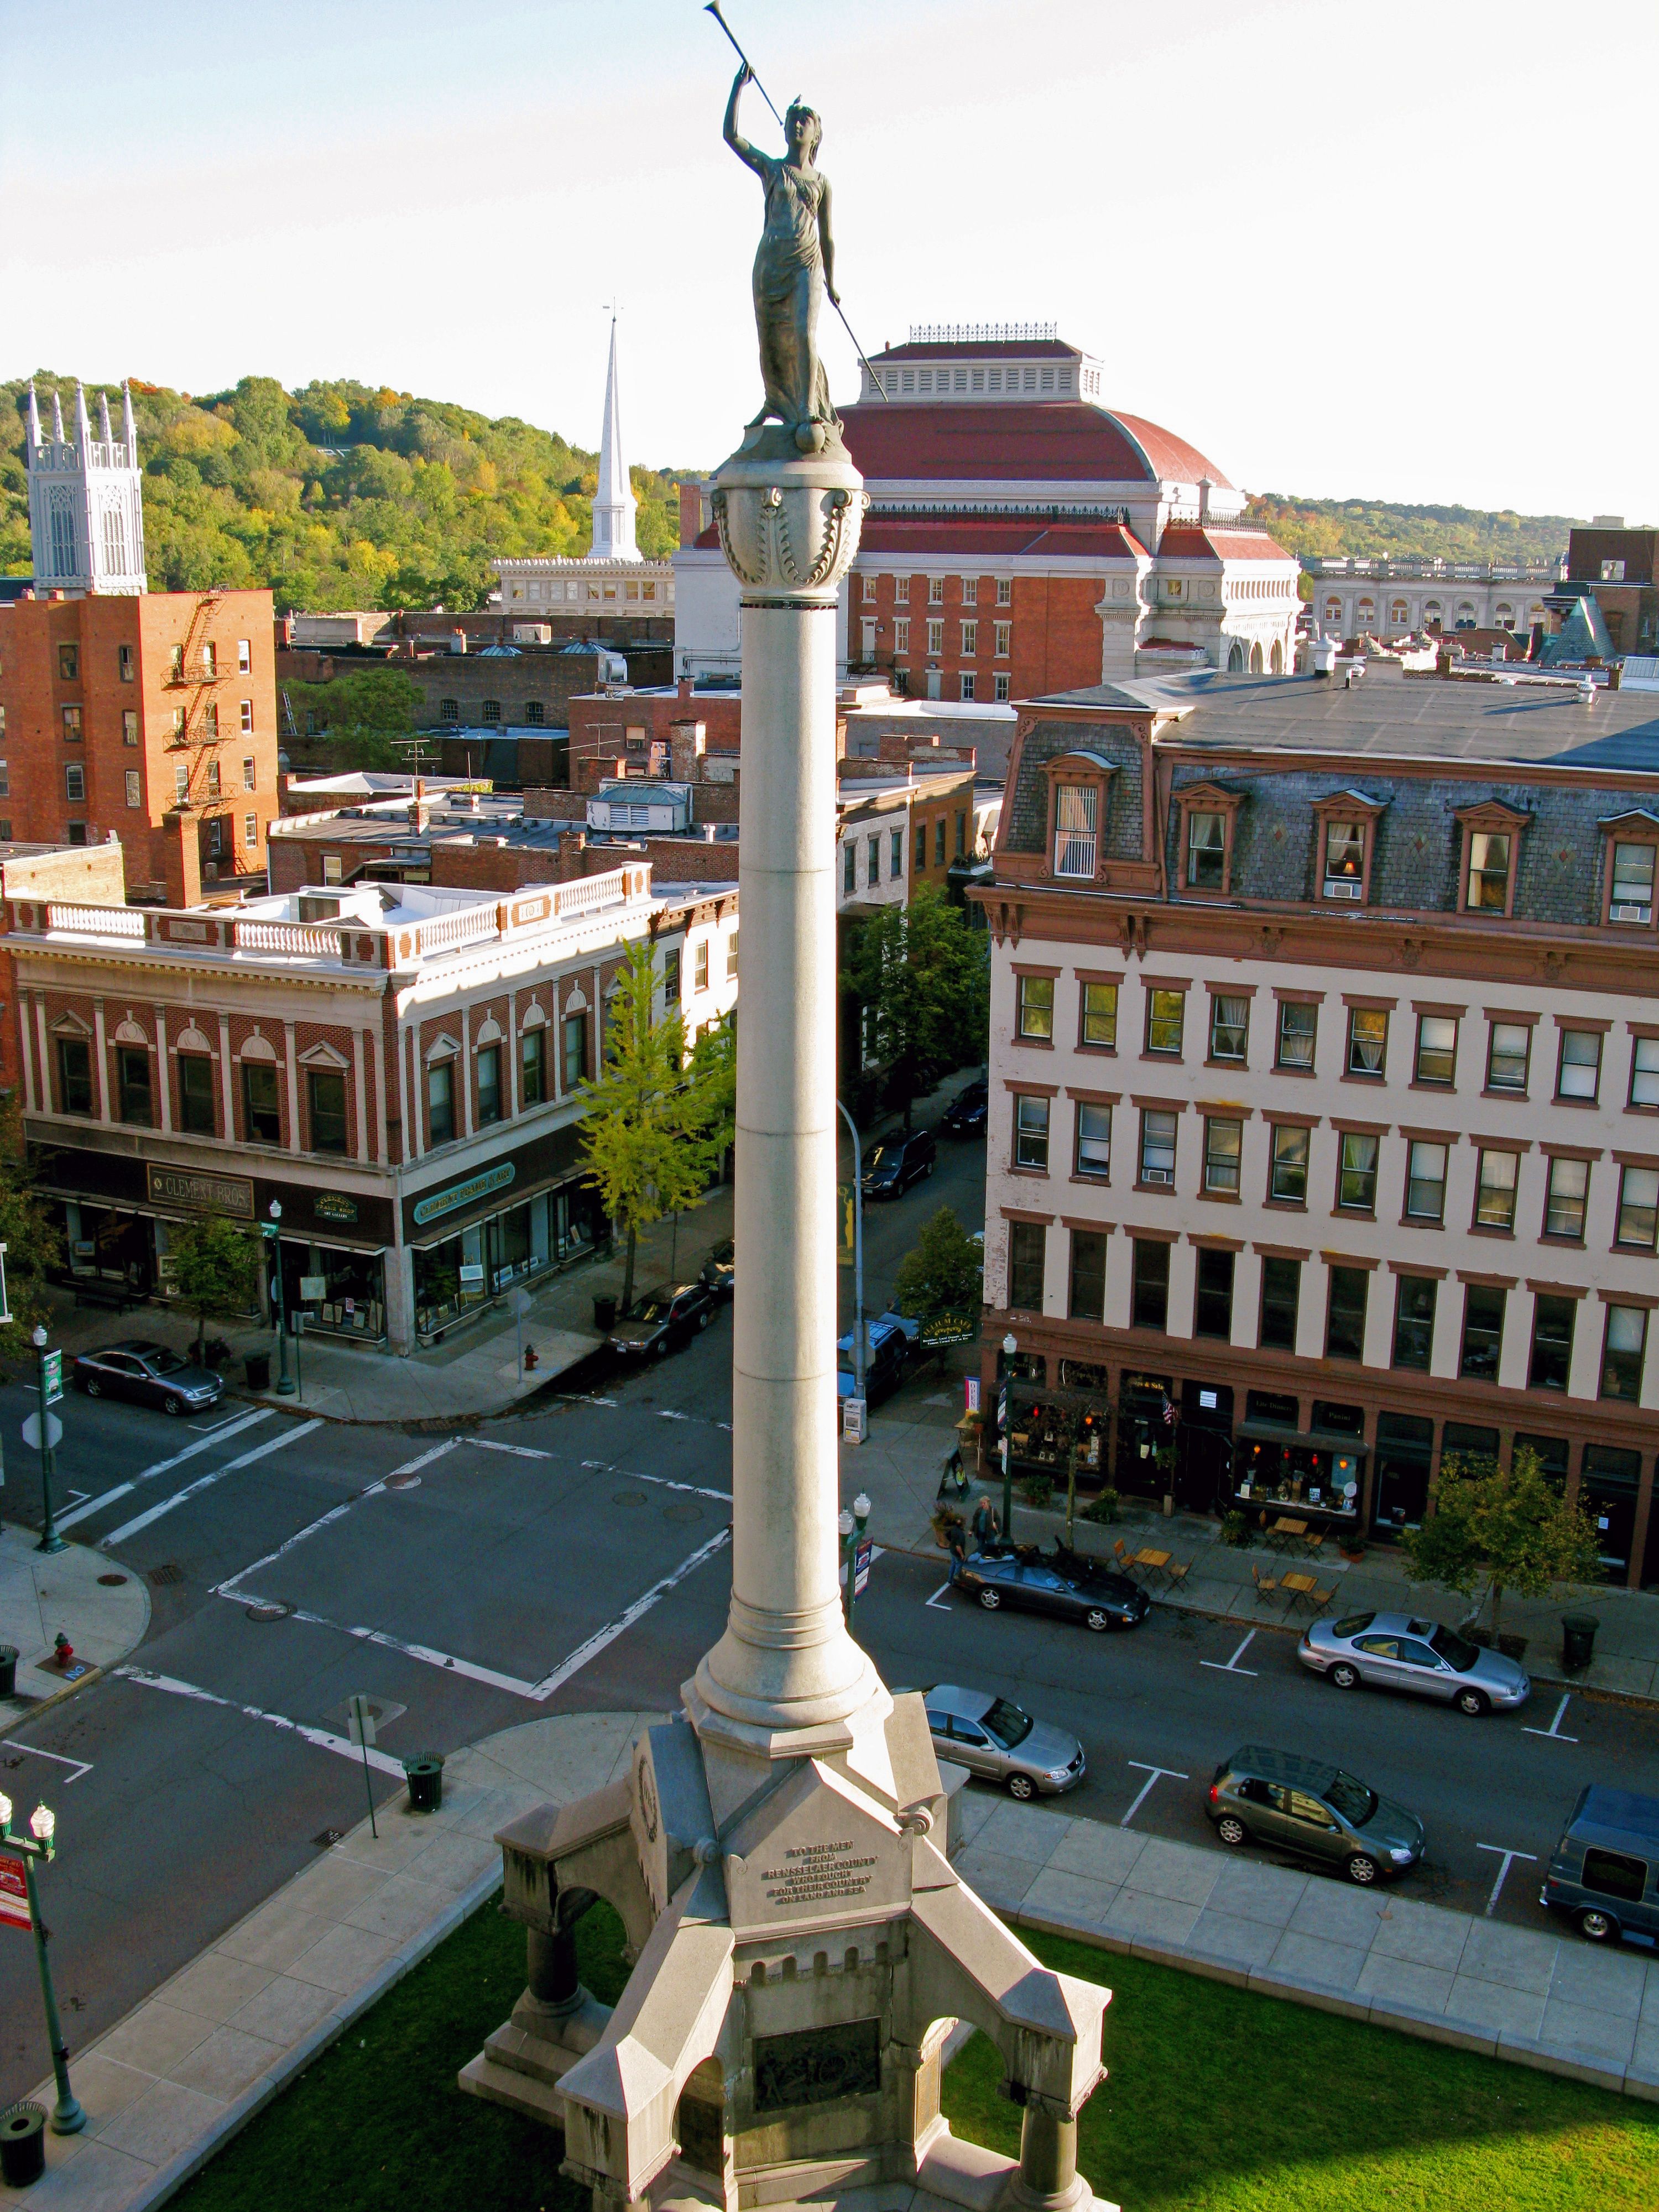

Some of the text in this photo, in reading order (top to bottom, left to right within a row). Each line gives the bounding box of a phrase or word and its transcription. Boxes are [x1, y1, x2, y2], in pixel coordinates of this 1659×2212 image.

[165, 1176, 213, 1201] CLEMENT
[420, 1193, 458, 1217] CLEMENT
[460, 1180, 486, 1199] FRAME
[495, 1168, 510, 1182] ART
[1328, 1411, 1351, 1421] Panini
[791, 1840, 854, 1856] TO THE MEN
[768, 1855, 879, 1878] RENSSELAER COUNTY
[809, 1852, 837, 1864] FROM
[773, 1875, 874, 1896] FOR THEIR COUNTRY
[792, 1869, 854, 1884] WHO FOUGHT
[782, 1885, 867, 1903] ON LAND AND SEA
